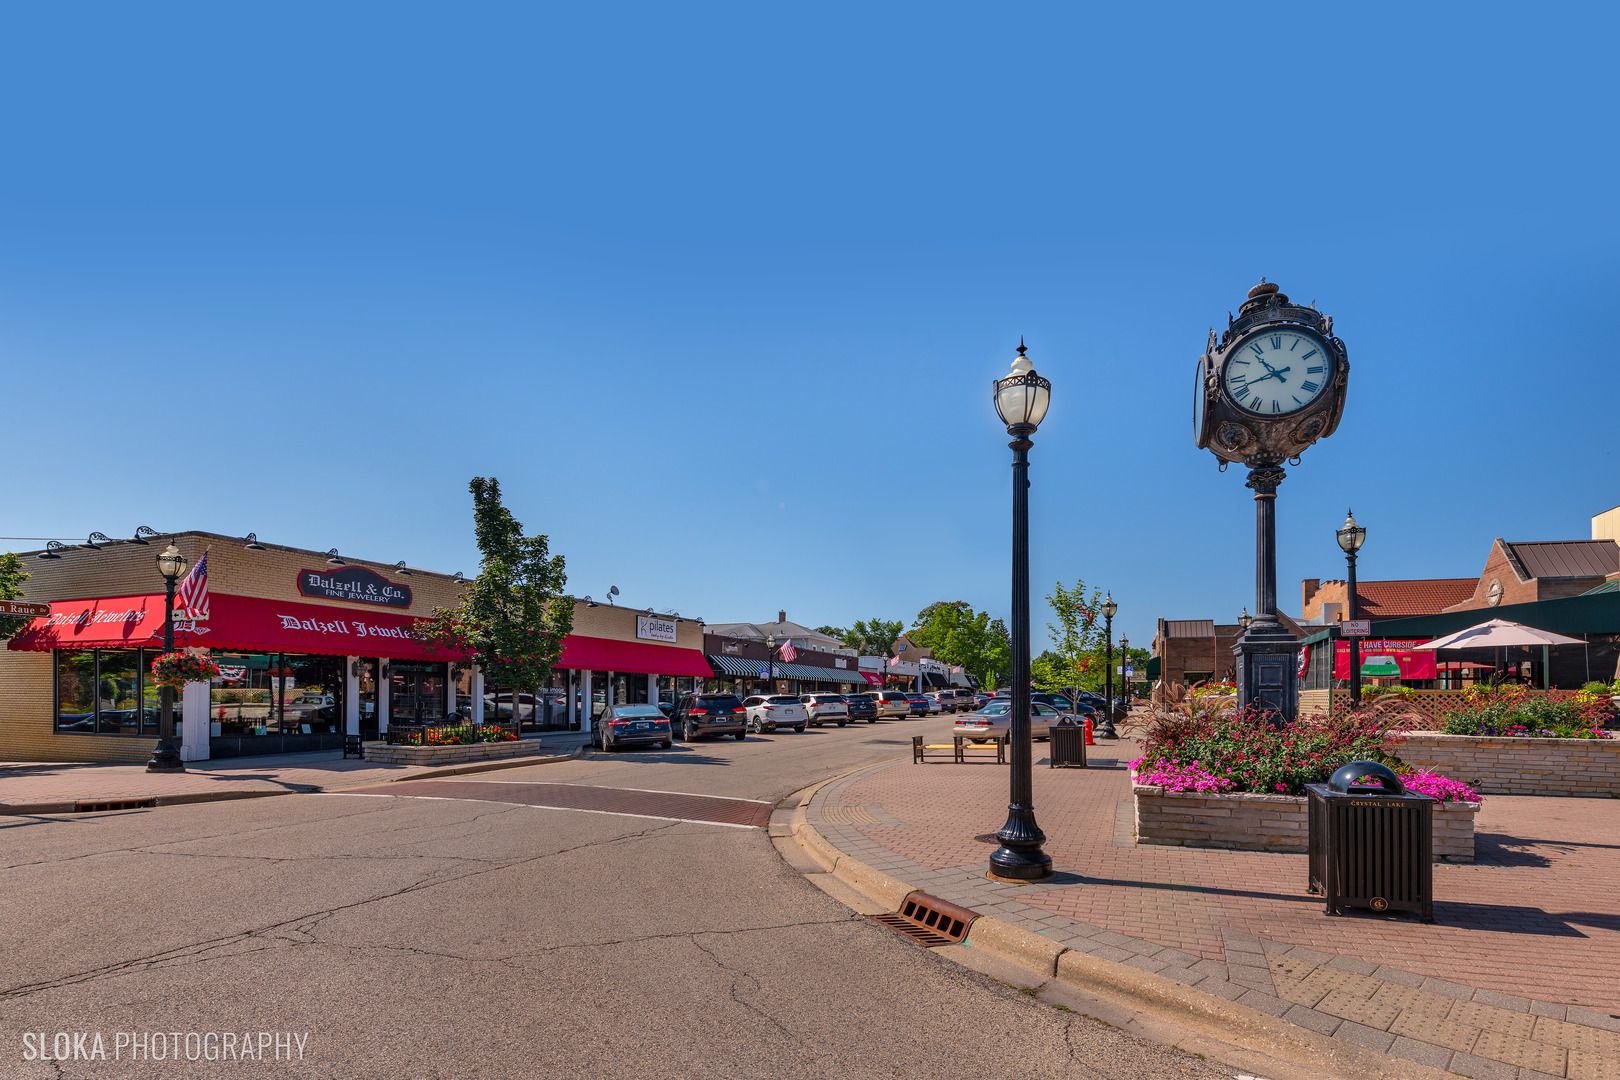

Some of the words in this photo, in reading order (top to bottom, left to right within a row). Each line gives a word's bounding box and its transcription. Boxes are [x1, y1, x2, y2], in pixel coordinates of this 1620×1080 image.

[308, 573, 361, 593] Dalzell
[366, 583, 378, 596] &
[381, 586, 405, 599] Co.
[325, 588, 345, 598] FINE
[347, 592, 391, 603] JEWELERY
[10, 604, 36, 614] Raue
[43, 612, 90, 627] Dalzell
[84, 609, 150, 626] Jewelers
[276, 613, 350, 635] Dalzell
[649, 620, 674, 634] pilates
[1363, 641, 1383, 649] HAVE
[1383, 641, 1417, 649] CURBSIDE
